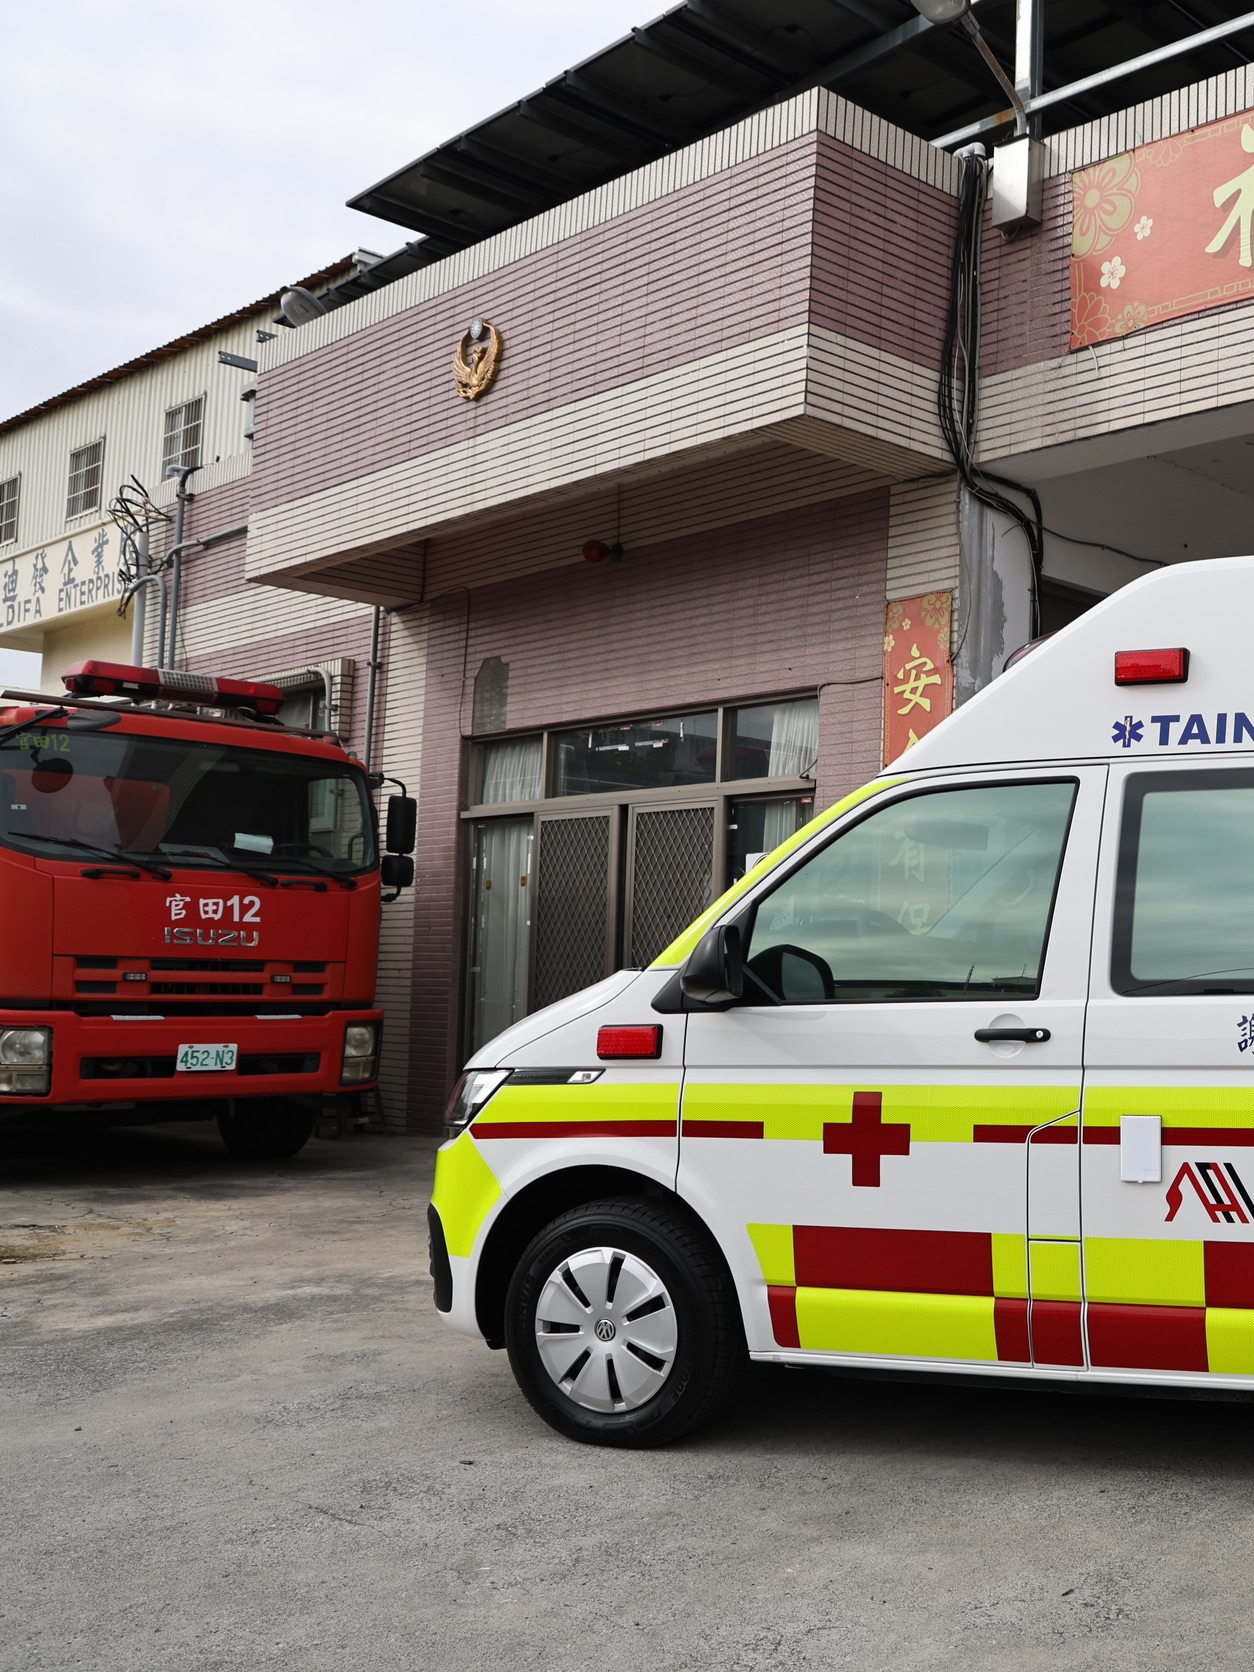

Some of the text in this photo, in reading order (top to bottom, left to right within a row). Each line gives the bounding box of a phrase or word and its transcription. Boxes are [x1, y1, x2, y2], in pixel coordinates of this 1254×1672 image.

[0, 596, 42, 628] DIFA
[15, 731, 70, 752] 官田12
[165, 893, 261, 923] 官田12
[164, 927, 259, 947] ISUZU
[179, 1049, 235, 1067] 452-N3
